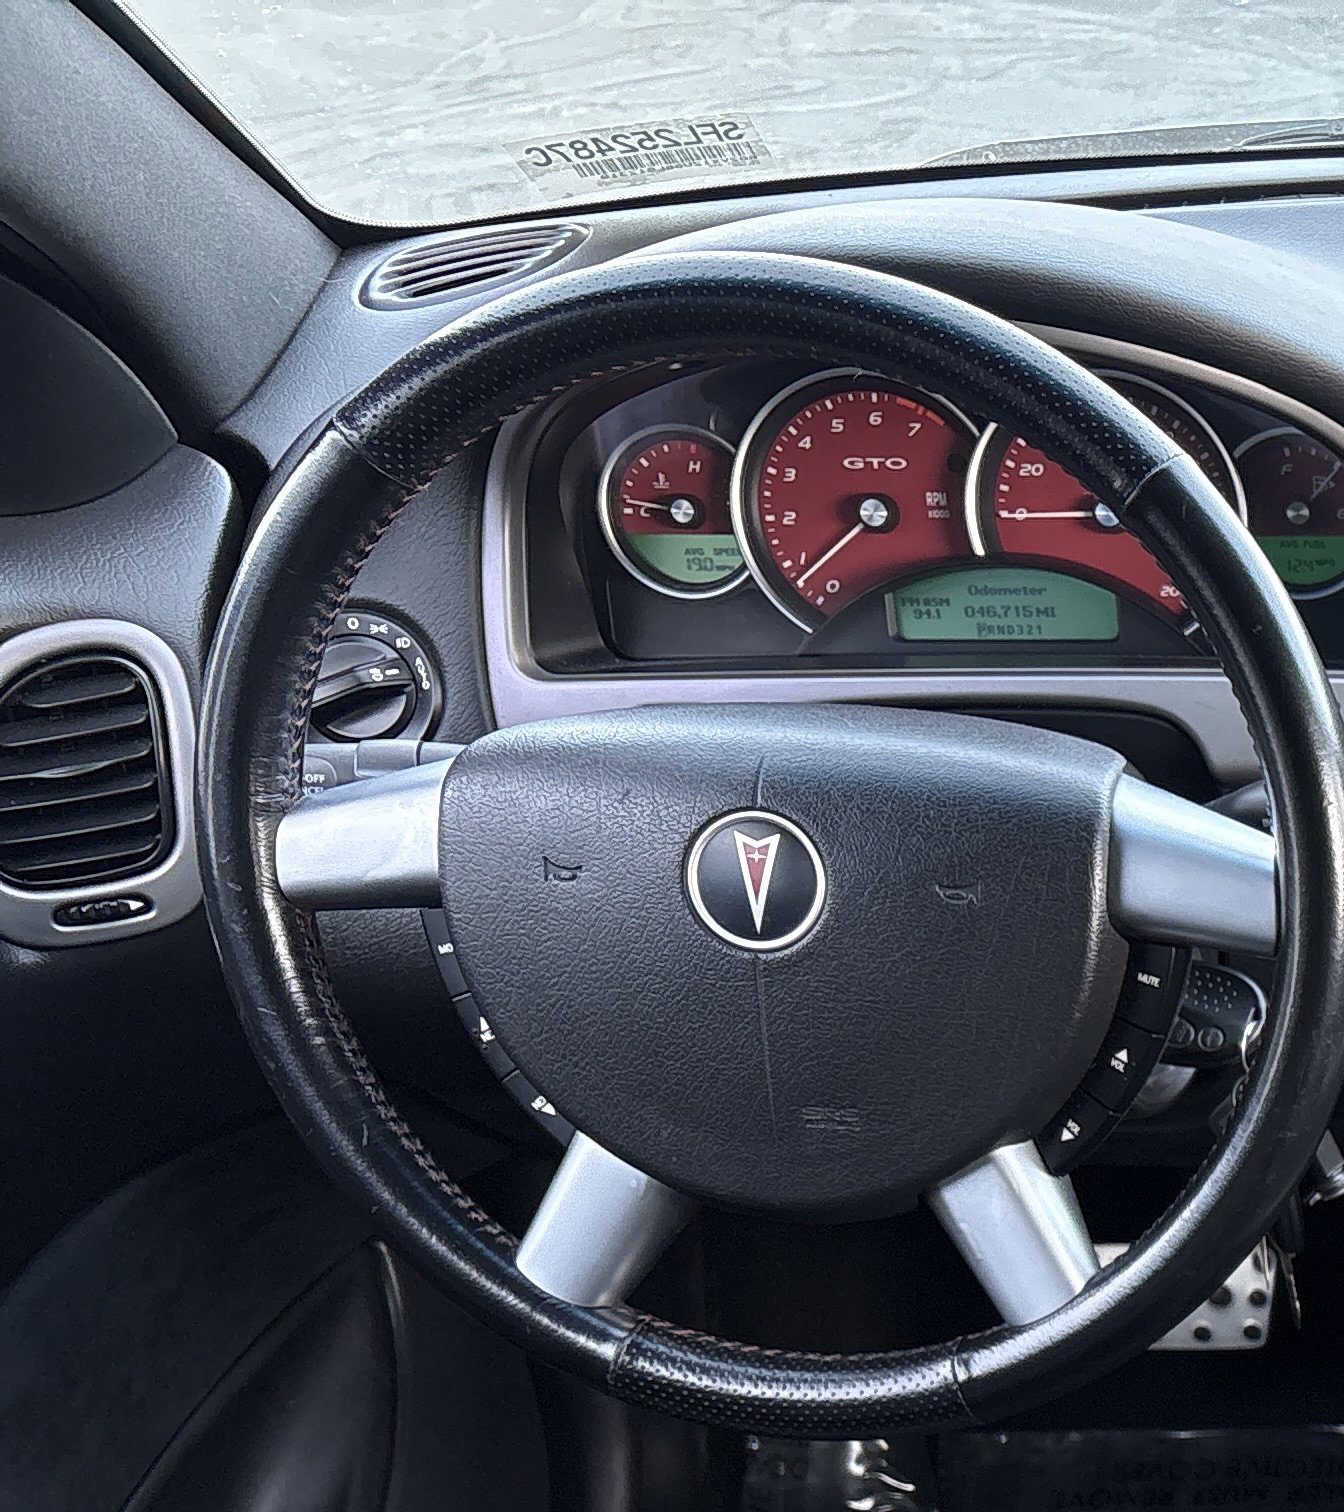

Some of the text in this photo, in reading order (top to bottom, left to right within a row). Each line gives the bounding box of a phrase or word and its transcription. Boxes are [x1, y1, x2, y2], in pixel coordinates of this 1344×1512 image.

[830, 418, 845, 433] 5
[869, 411, 882, 425] 6
[907, 422, 922, 437] 7
[797, 435, 813, 450] 4
[688, 460, 703, 474] H
[842, 456, 909, 471] GTO
[1018, 462, 1045, 477] 20
[782, 467, 797, 482] 3
[782, 511, 797, 526] 2
[799, 551, 807, 566] 1
[826, 579, 841, 594] 0
[967, 584, 1048, 597] Odometer
[1136, 971, 1161, 989] MUTE
